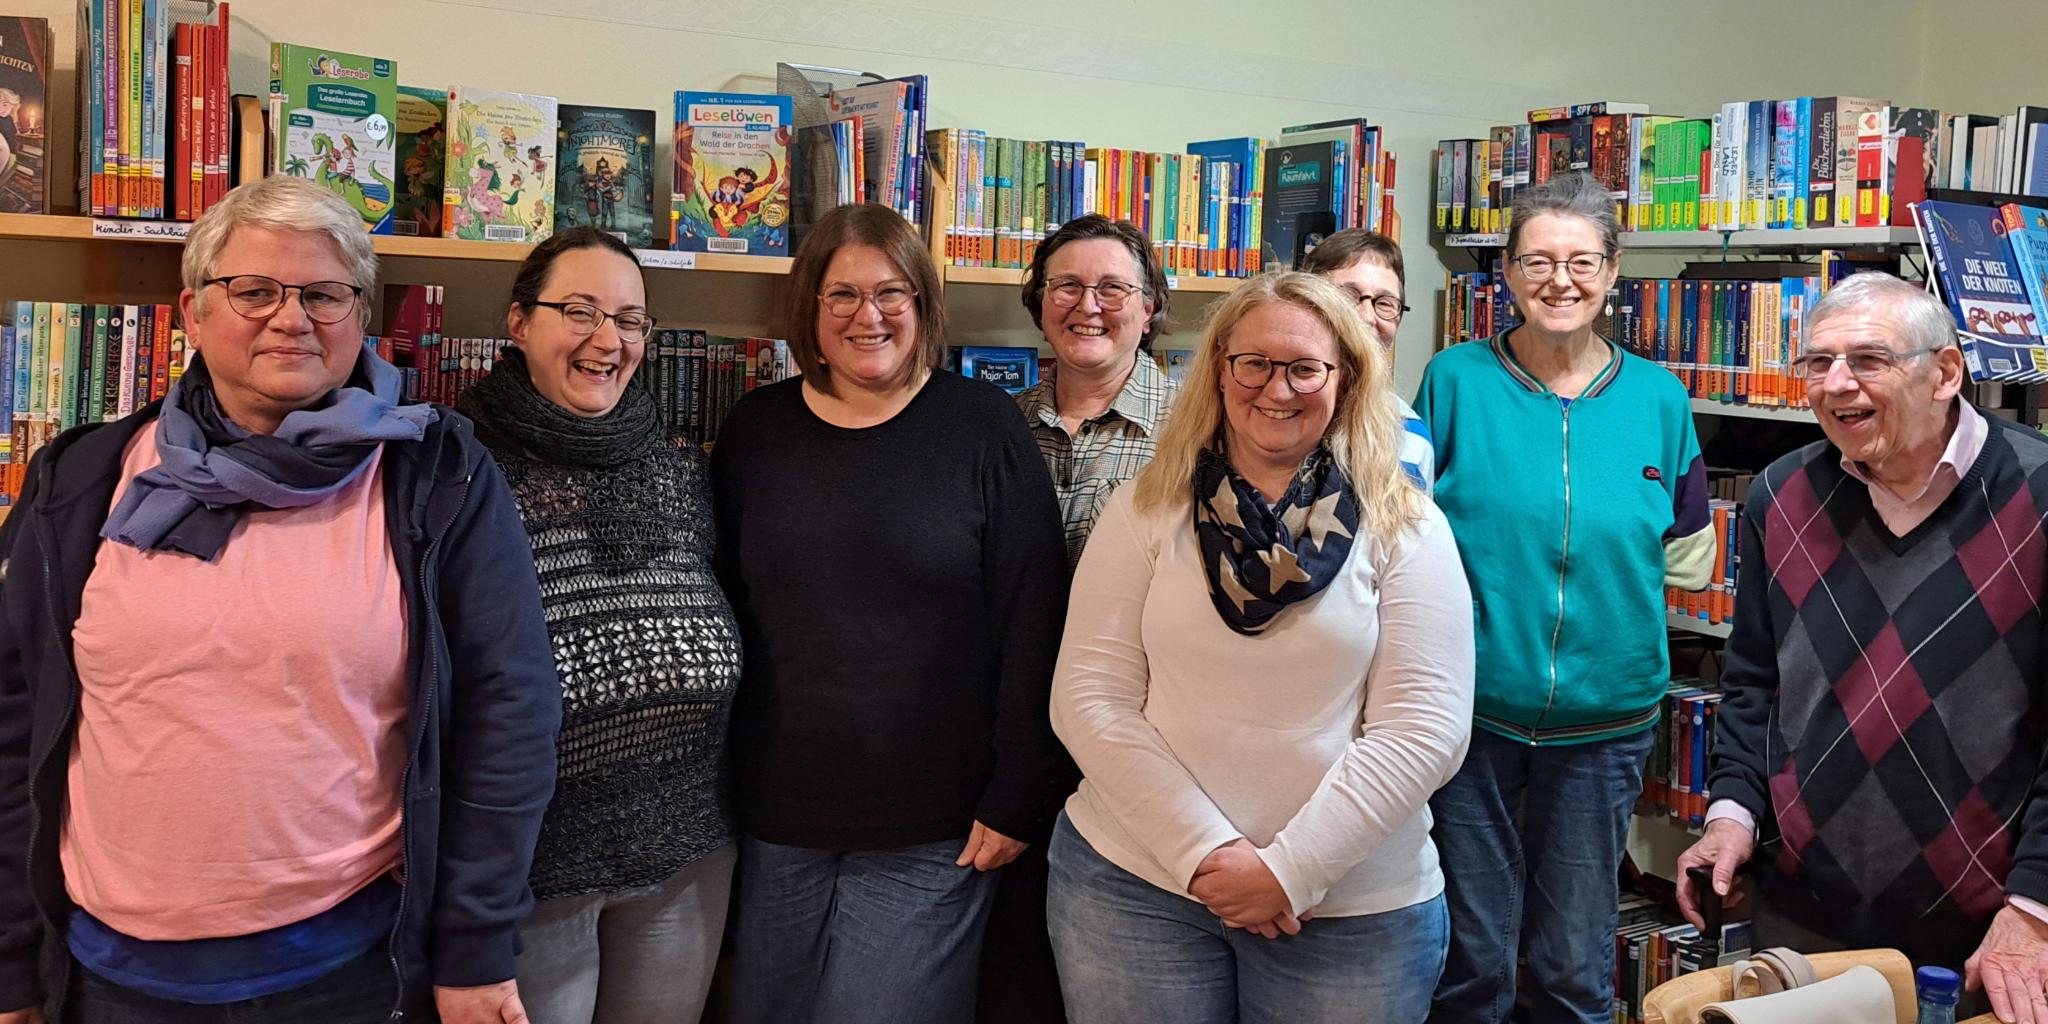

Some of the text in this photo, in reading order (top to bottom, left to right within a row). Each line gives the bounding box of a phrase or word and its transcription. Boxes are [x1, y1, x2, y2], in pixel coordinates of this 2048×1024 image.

[333, 66, 369, 80] Leserabe
[145, 80, 153, 102] HAIE
[320, 95, 366, 107] Leselernbuch
[694, 108, 773, 123] Leselöwen
[1577, 104, 1592, 116] SPY
[700, 140, 770, 150] Wald der Drachen
[712, 131, 759, 140] Reise in den
[1818, 111, 1831, 179] Bücherdiebin
[1812, 158, 1820, 170] Die
[1281, 170, 1317, 183] Raumfahrt
[1747, 171, 1756, 191] OHNE
[1755, 178, 1764, 201] NICHT
[96, 222, 133, 234] Kinder
[2004, 208, 2016, 229] TOPP
[1930, 231, 1939, 245] DER
[1934, 246, 1944, 261] WELT
[1938, 260, 1948, 272] DIE
[1964, 258, 2008, 278] DIE WELT
[1962, 274, 1985, 291] DER
[1984, 276, 2022, 295] KNOTEN
[36, 325, 46, 356] Hotzenplotz
[18, 334, 29, 409] Der Räuber Hotzenplotz
[35, 357, 44, 378] Räuber
[92, 333, 105, 417] DER KLEINE WASSERMANN
[104, 334, 121, 416] DIE KLEINE HEXE
[692, 359, 700, 389] FLOHLING
[980, 370, 1019, 382] Major Tom
[51, 374, 61, 408] Hotzenplotz
[65, 375, 76, 410] Hotzenplotz
[122, 373, 133, 399] Kleine
[34, 392, 43, 409] Neues
[121, 398, 131, 413] Das
